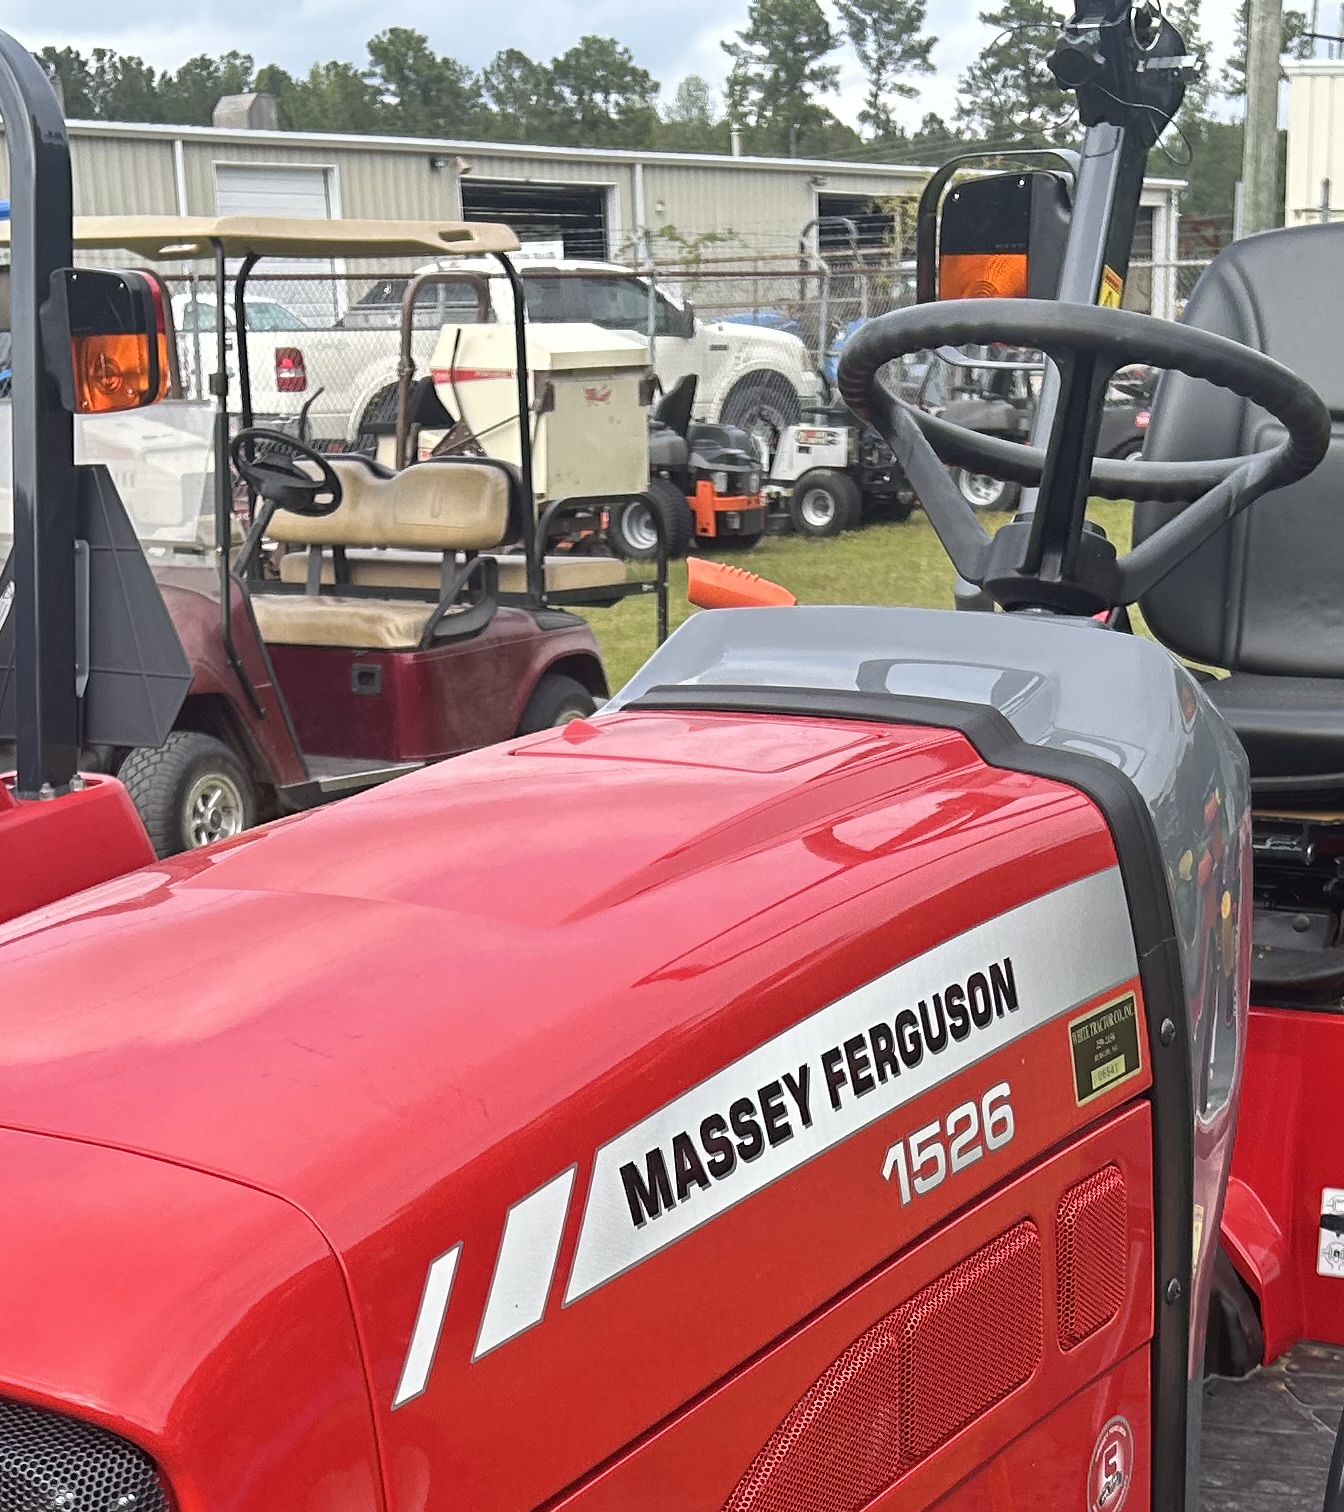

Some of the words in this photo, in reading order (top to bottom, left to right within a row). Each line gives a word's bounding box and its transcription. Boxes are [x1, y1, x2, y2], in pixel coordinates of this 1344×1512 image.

[619, 1064, 814, 1230] MASSEY
[821, 957, 1020, 1112] FERGUSON
[881, 1081, 1017, 1208] 1526
